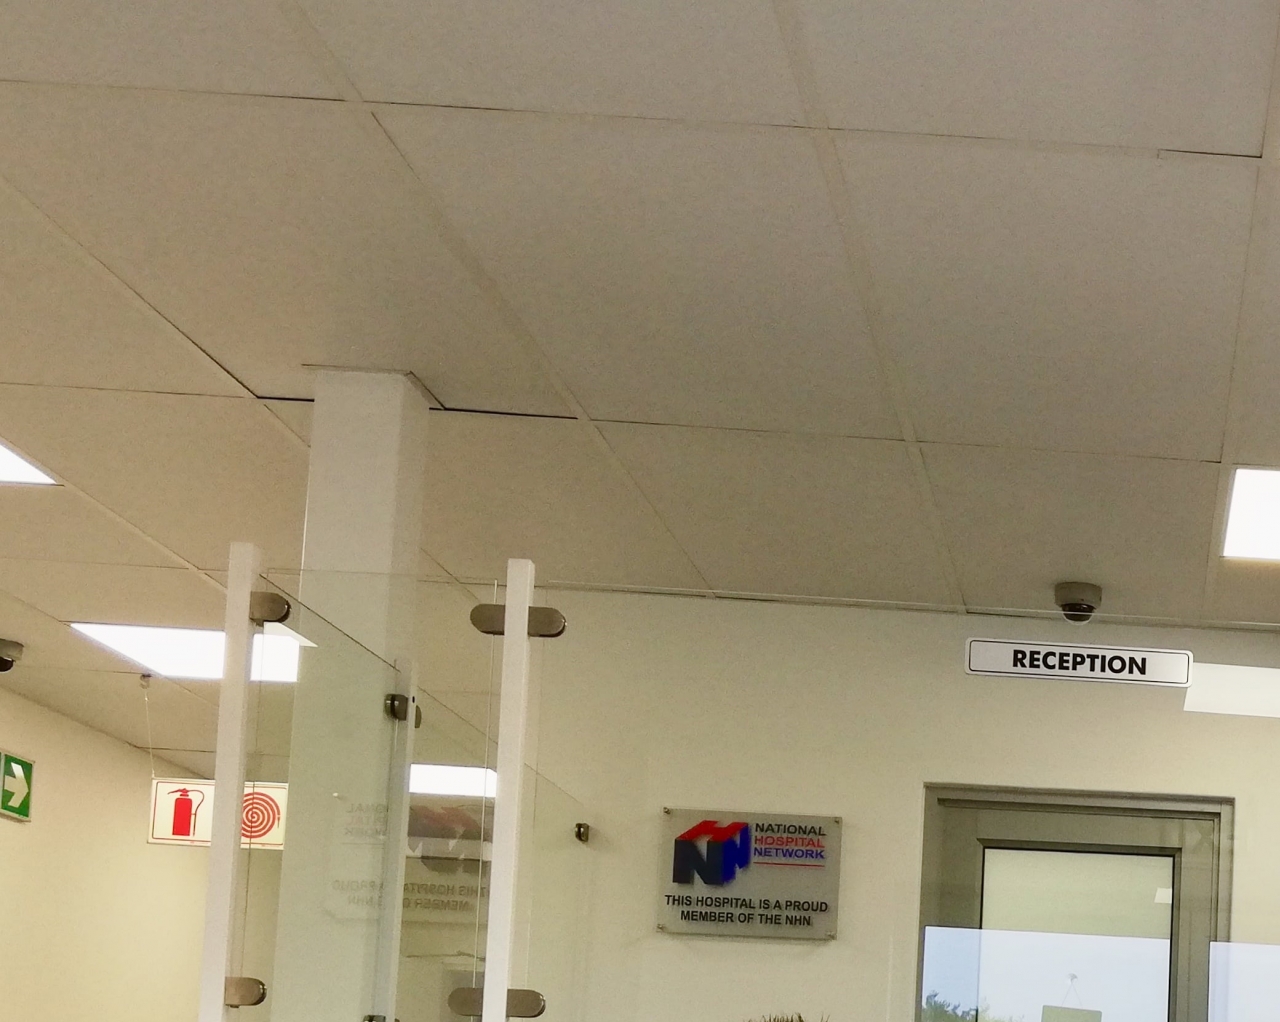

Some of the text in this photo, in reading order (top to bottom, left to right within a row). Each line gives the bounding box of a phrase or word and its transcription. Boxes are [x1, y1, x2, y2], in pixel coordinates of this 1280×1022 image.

[1012, 649, 1147, 675] RECEPTION
[755, 823, 827, 837] NATIONAL
[754, 835, 825, 848] HOSPITAL
[753, 847, 825, 860] NETWORK
[665, 894, 828, 913] THIS HOSPITAL IS A PROUD
[680, 910, 811, 926] MEMBER OF THE NHN
